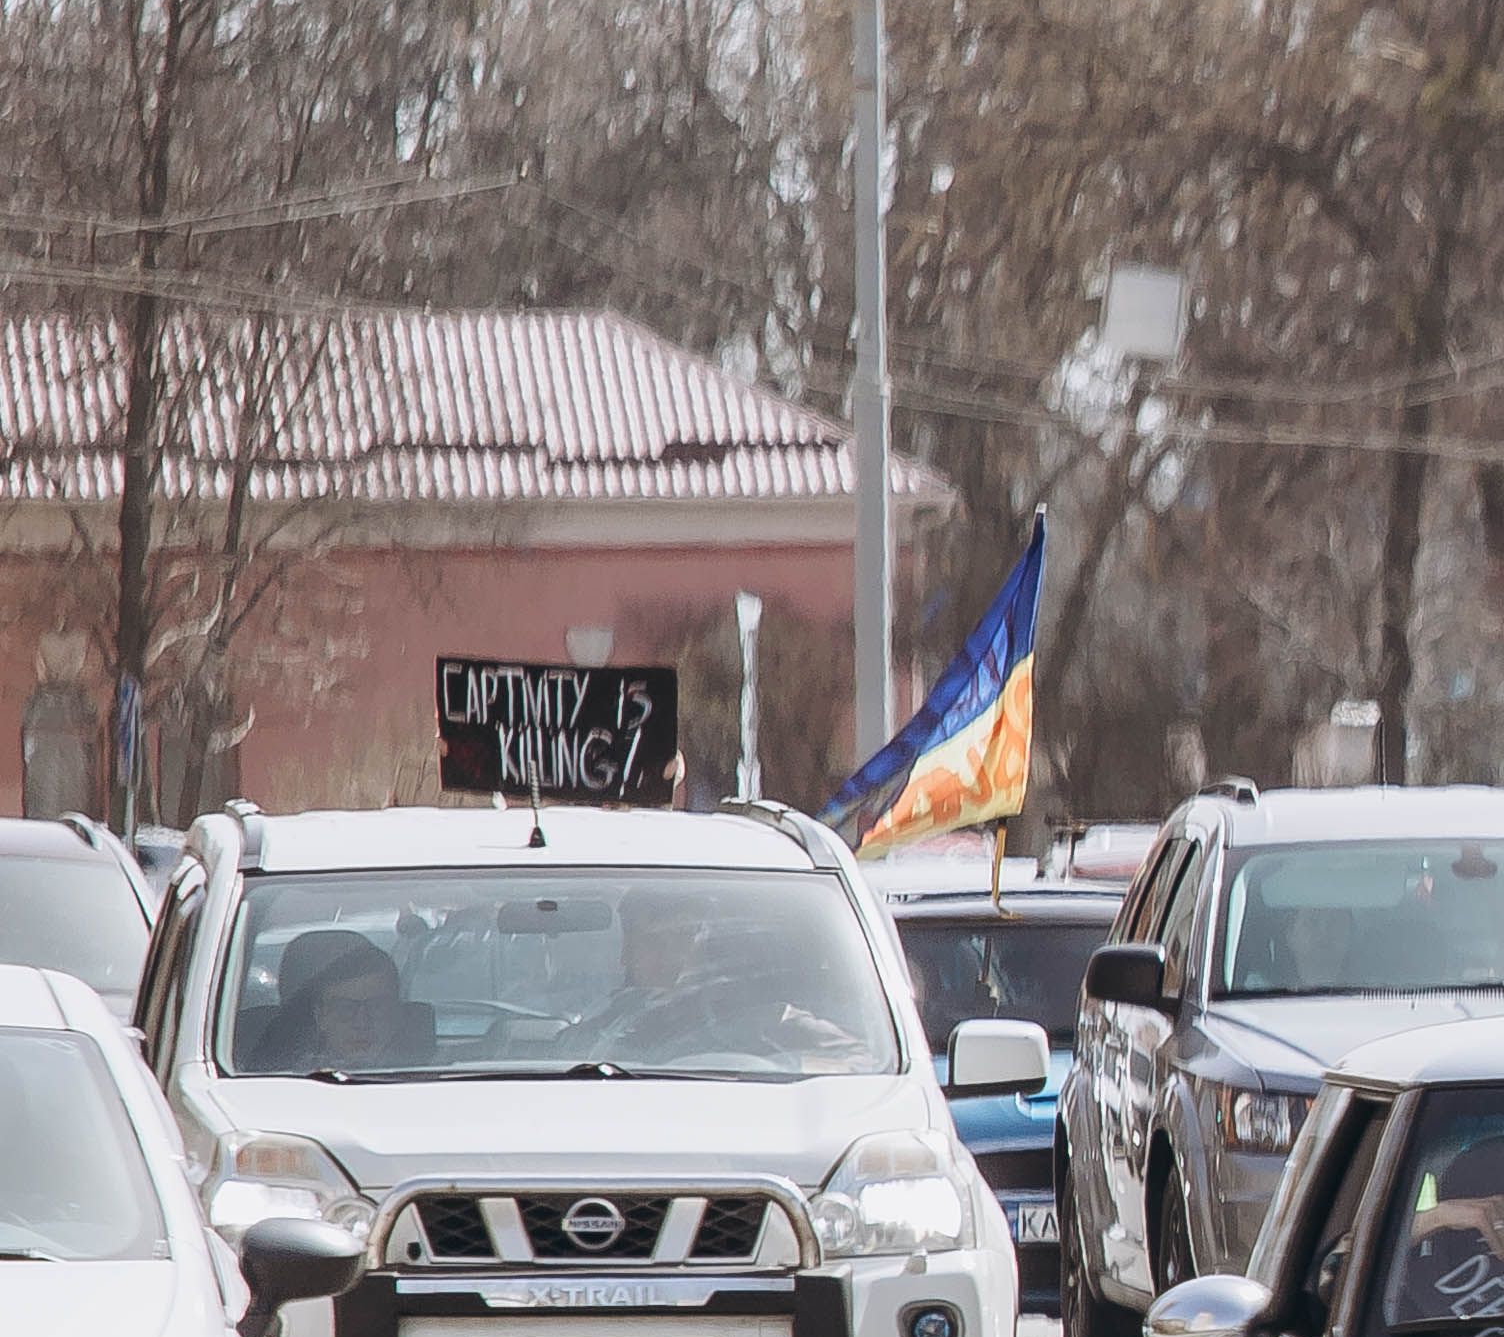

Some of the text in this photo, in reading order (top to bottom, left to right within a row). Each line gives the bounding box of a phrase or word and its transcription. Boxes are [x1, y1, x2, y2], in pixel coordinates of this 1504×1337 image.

[443, 663, 652, 730] CAPTIVITY IS
[529, 1286, 660, 1305] X-TRAIL
